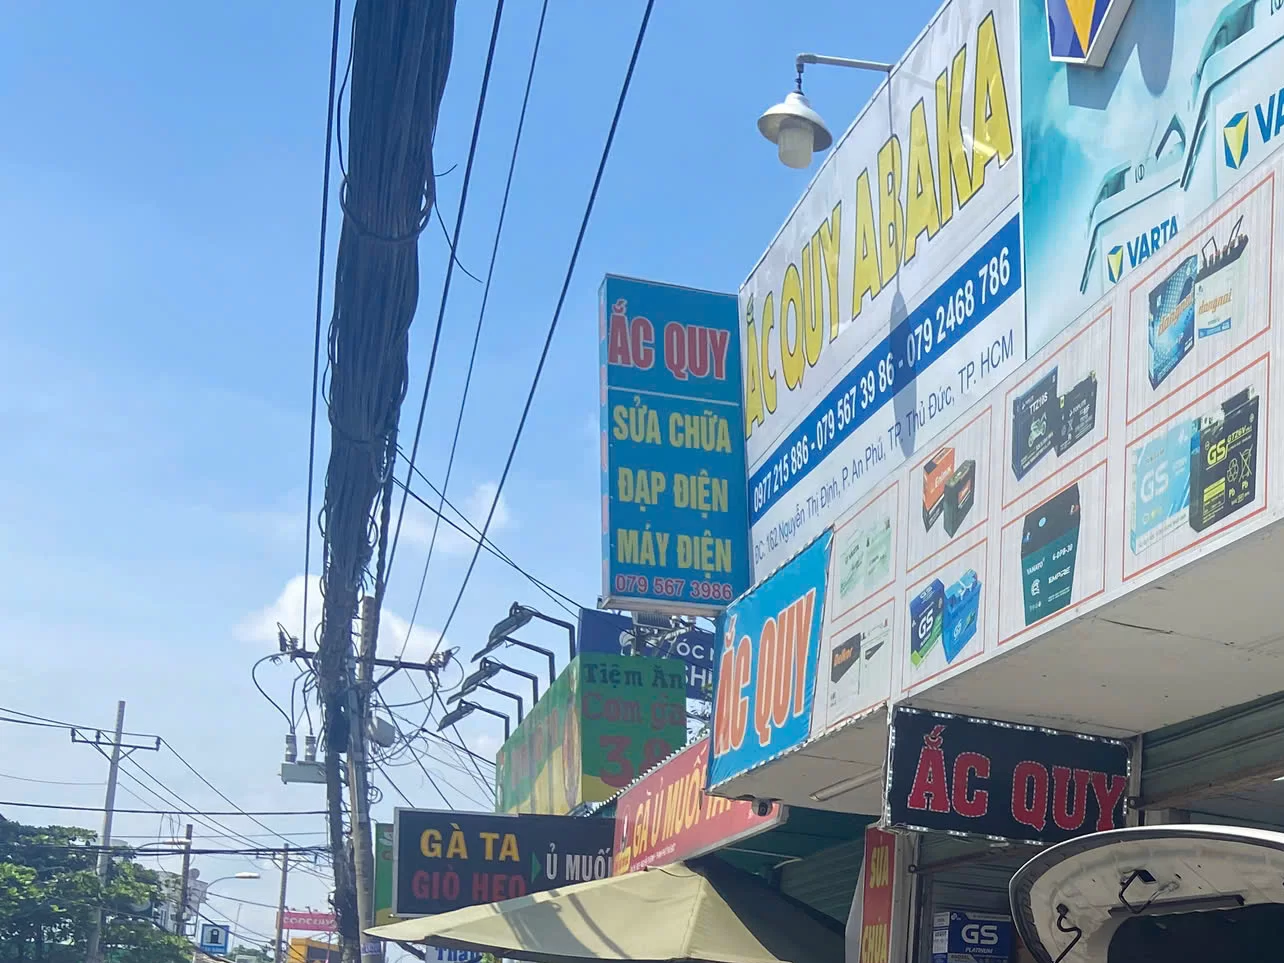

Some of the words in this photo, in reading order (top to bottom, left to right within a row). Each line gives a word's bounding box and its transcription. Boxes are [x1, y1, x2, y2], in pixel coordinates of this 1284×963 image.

[780, 200, 842, 391] QUY
[852, 9, 1013, 322] ABAKA
[1127, 215, 1179, 269] VARTA
[608, 298, 655, 371] ẮC
[664, 320, 731, 381] QUY
[753, 471, 772, 513] 0977
[773, 453, 789, 494] 215
[790, 435, 809, 475] 886
[816, 409, 835, 451] 079
[837, 386, 857, 431] 567
[860, 370, 875, 410] 39
[878, 352, 895, 393] 86
[906, 317, 933, 368] 079
[935, 279, 975, 345] 2468
[978, 246, 1011, 305] 786
[613, 396, 662, 445] SỬA
[669, 410, 733, 454] CHỮA
[766, 527, 779, 551] 162
[778, 503, 806, 544] Nguyễn
[851, 458, 864, 483] An
[905, 400, 926, 437] Thủ
[957, 361, 977, 395] TP.
[980, 328, 1015, 379] HCM
[1207, 439, 1227, 467] GS
[618, 467, 666, 513] ĐẠP
[673, 468, 729, 519] ĐIỆN
[617, 522, 670, 568] MÁY
[676, 530, 733, 579] ĐIỆN
[615, 575, 649, 593] 079
[653, 576, 685, 597] 567
[690, 580, 734, 601] 3986
[918, 608, 934, 639] GS
[713, 613, 752, 759] ẮC
[755, 586, 817, 747] QUY
[906, 725, 991, 819] ẮC
[1011, 760, 1128, 832] QUY
[420, 823, 469, 860] GÀ
[479, 831, 520, 863] TA
[546, 842, 558, 880] Ủ
[961, 924, 999, 945] GS
